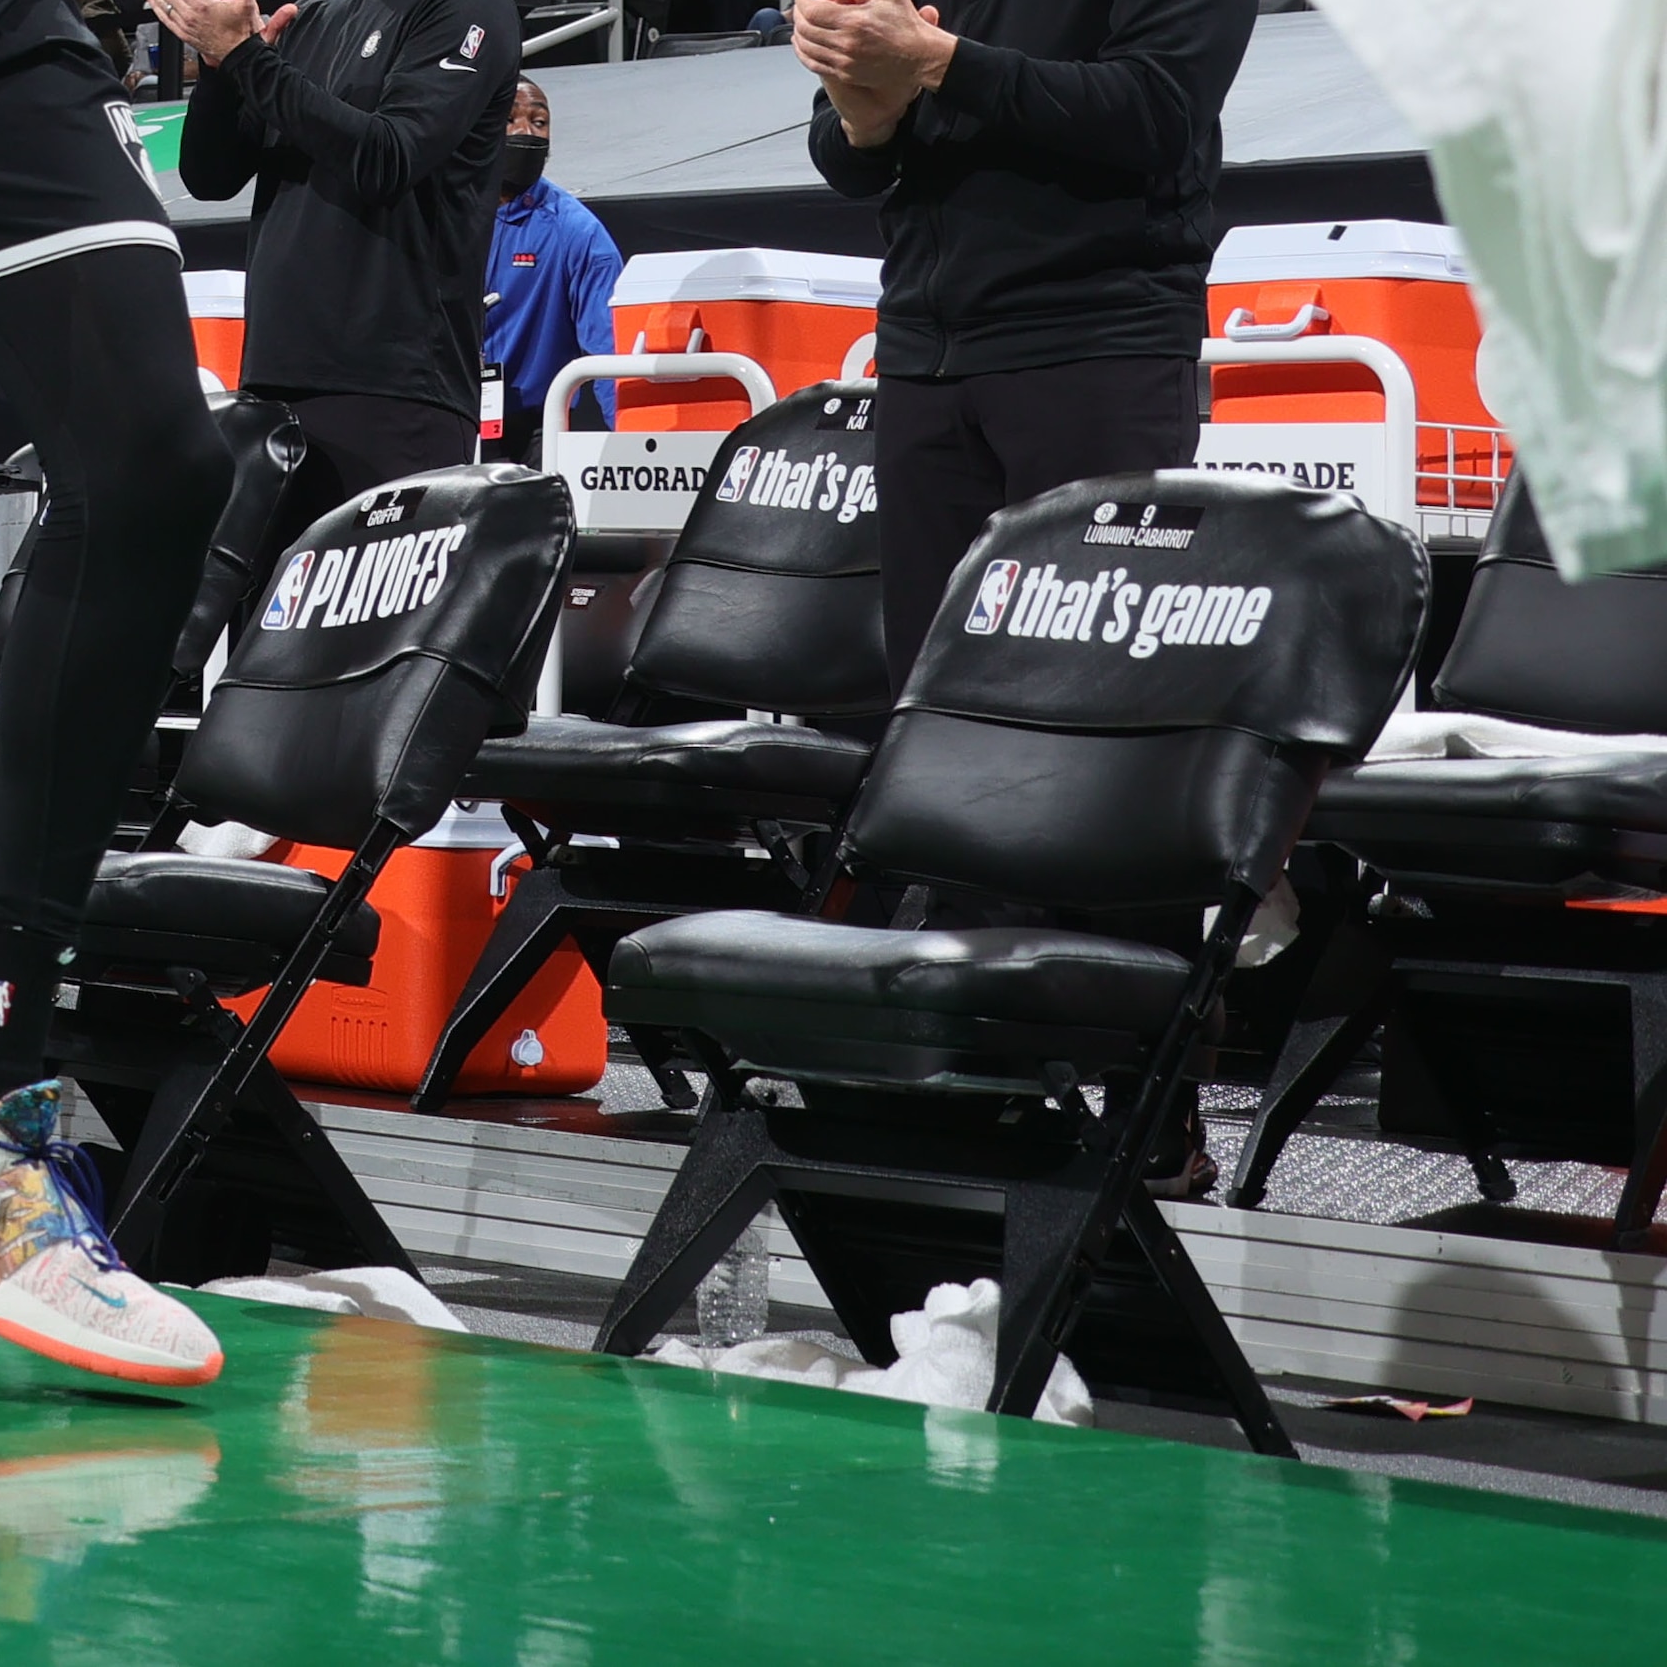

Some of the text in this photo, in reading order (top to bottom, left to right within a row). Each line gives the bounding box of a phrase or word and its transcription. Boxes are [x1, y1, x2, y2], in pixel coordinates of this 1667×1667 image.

[856, 398, 873, 416] 11
[748, 448, 849, 512] that's
[1193, 462, 1356, 490] ATORADE
[387, 489, 400, 507] 2
[367, 506, 405, 528] GRIFFIN
[1140, 504, 1157, 526] 9
[1083, 523, 1195, 549] LUWAWU-CABARROT
[296, 523, 468, 629] PLAYOFFS
[969, 615, 989, 630] NBA
[1007, 563, 1273, 660] that's game
